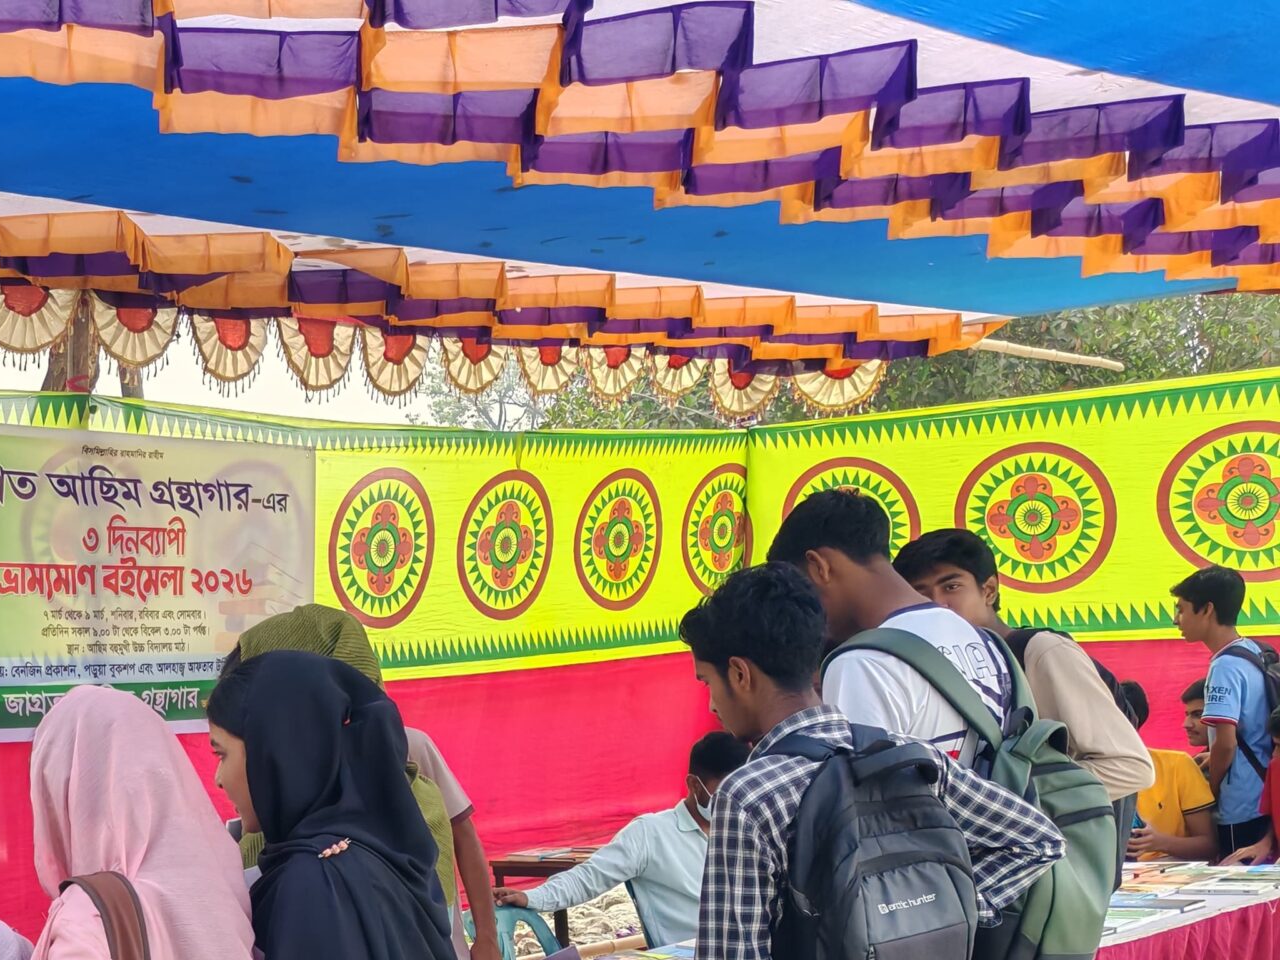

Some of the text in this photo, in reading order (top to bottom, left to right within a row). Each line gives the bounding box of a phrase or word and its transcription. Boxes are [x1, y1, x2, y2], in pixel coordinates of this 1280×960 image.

[46, 465, 143, 511] আছিম
[83, 514, 187, 556] ৩ দিনব্যাপী
[102, 557, 185, 600] বইমেলা
[191, 568, 253, 596] ২০২৬
[43, 610, 49, 621] ৭
[51, 607, 63, 620] মার্চ
[65, 610, 83, 620] থেকে
[139, 608, 159, 620] রবিবার
[162, 610, 175, 621] এবং
[41, 624, 69, 638] প্রতিদিন
[71, 627, 90, 637] সকাল
[112, 625, 120, 637] টা
[122, 627, 139, 637] থেকে
[141, 624, 161, 637] বিকেল
[183, 625, 191, 637] টা
[11, 662, 42, 678] বেনজিন
[109, 664, 135, 679] বুকশপ
[138, 663, 154, 676] এবং
[908, 893, 936, 907] hunter
